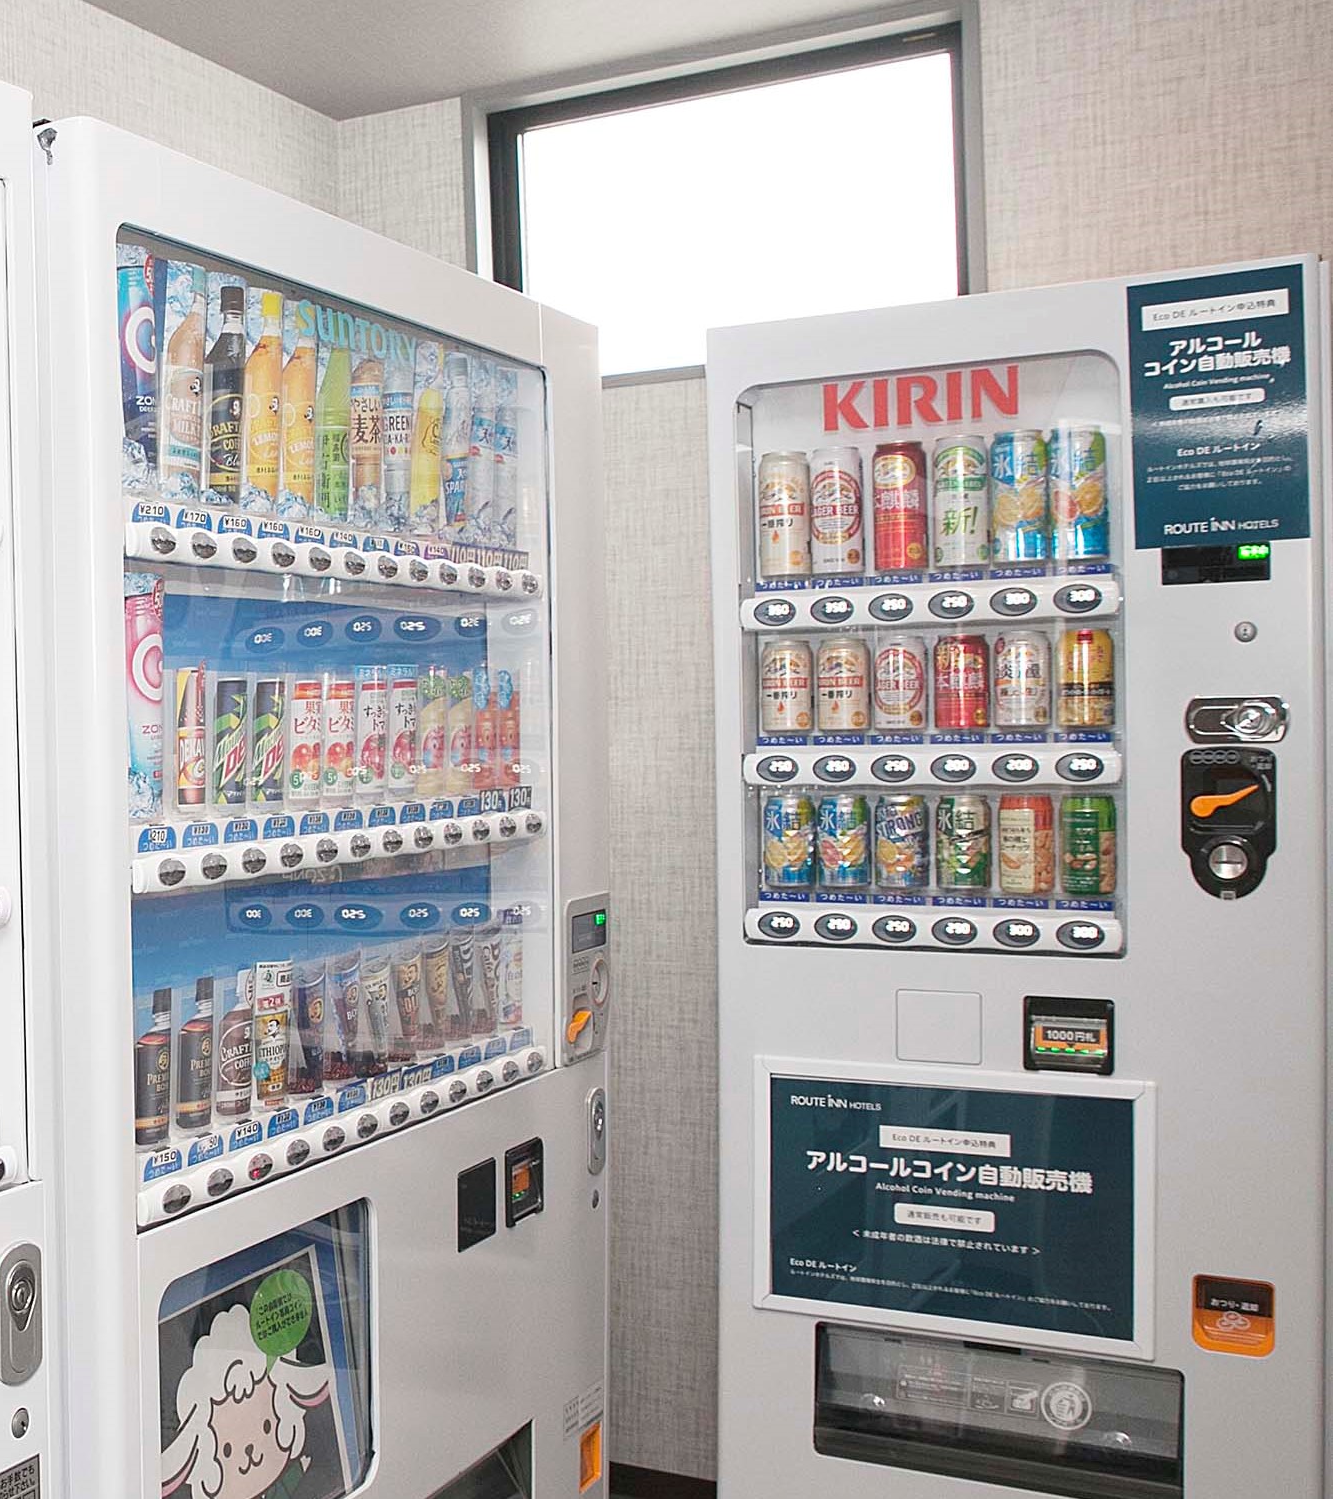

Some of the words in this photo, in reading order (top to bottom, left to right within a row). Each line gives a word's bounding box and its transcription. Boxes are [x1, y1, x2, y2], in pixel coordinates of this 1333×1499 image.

[1169, 332, 1262, 356] アルコール
[1144, 347, 1292, 377] コイン自動販売機
[823, 365, 1019, 432] KIRIN
[1177, 447, 1194, 457] Eco
[1196, 446, 1211, 455] DE
[140, 506, 164, 517] ¥210
[1164, 521, 1208, 535] ROUTE
[1238, 520, 1279, 530] HOTELS
[1046, 1029, 1097, 1044] 1000円札
[790, 1095, 826, 1107] ROUTE
[849, 1102, 882, 1112] HOTELS
[892, 1134, 907, 1142] Eco
[909, 1135, 920, 1143] DE
[806, 1150, 1093, 1194] アルコールコイン自動販売機
[875, 1182, 910, 1193] Alcohol
[912, 1186, 933, 1195] Coin
[936, 1188, 973, 1200] Vending
[975, 1192, 1015, 1202] machine
[790, 1258, 805, 1268] Eco
[806, 1260, 817, 1269] DE
[818, 1262, 857, 1273] ルートイン
